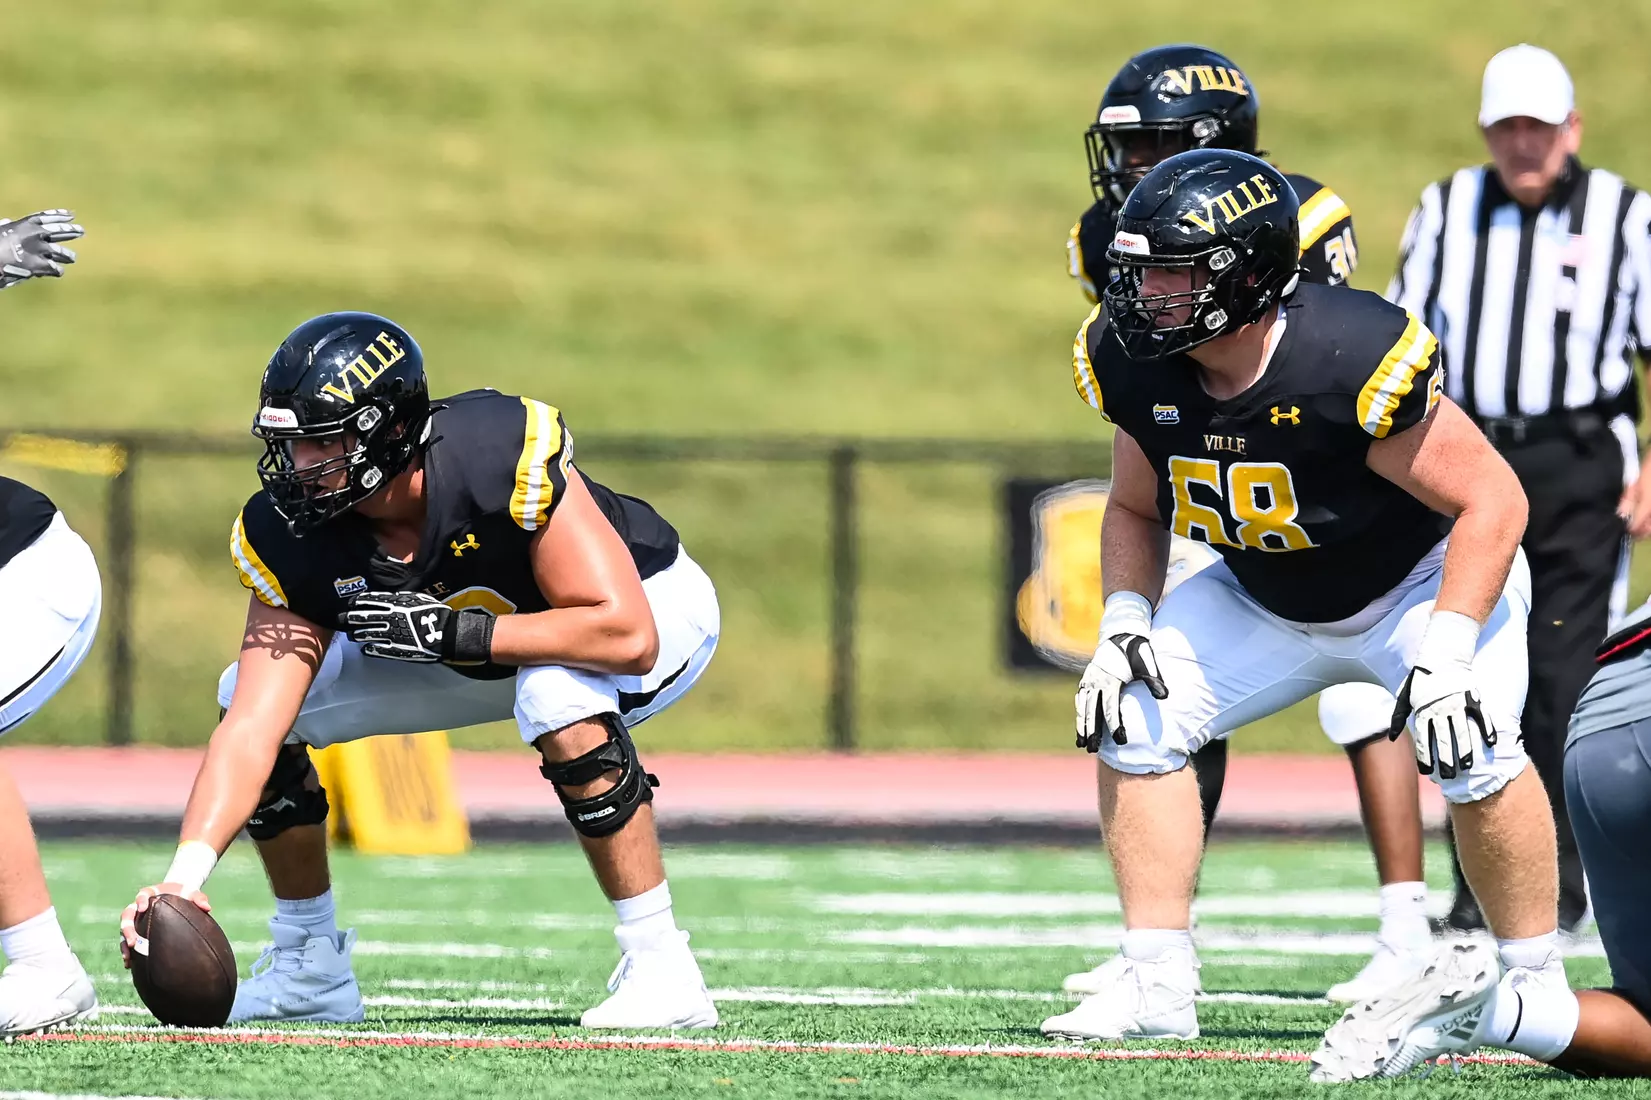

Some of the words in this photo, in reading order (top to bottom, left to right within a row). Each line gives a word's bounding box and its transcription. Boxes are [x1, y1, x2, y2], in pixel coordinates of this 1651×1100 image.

[1164, 65, 1249, 95] VILLE
[1183, 174, 1278, 235] VILLE
[321, 331, 405, 404] VILLE
[1155, 411, 1178, 419] PSAC
[1203, 434, 1247, 455] VILLE
[1168, 455, 1321, 553] 68
[338, 580, 365, 593] PSAC
